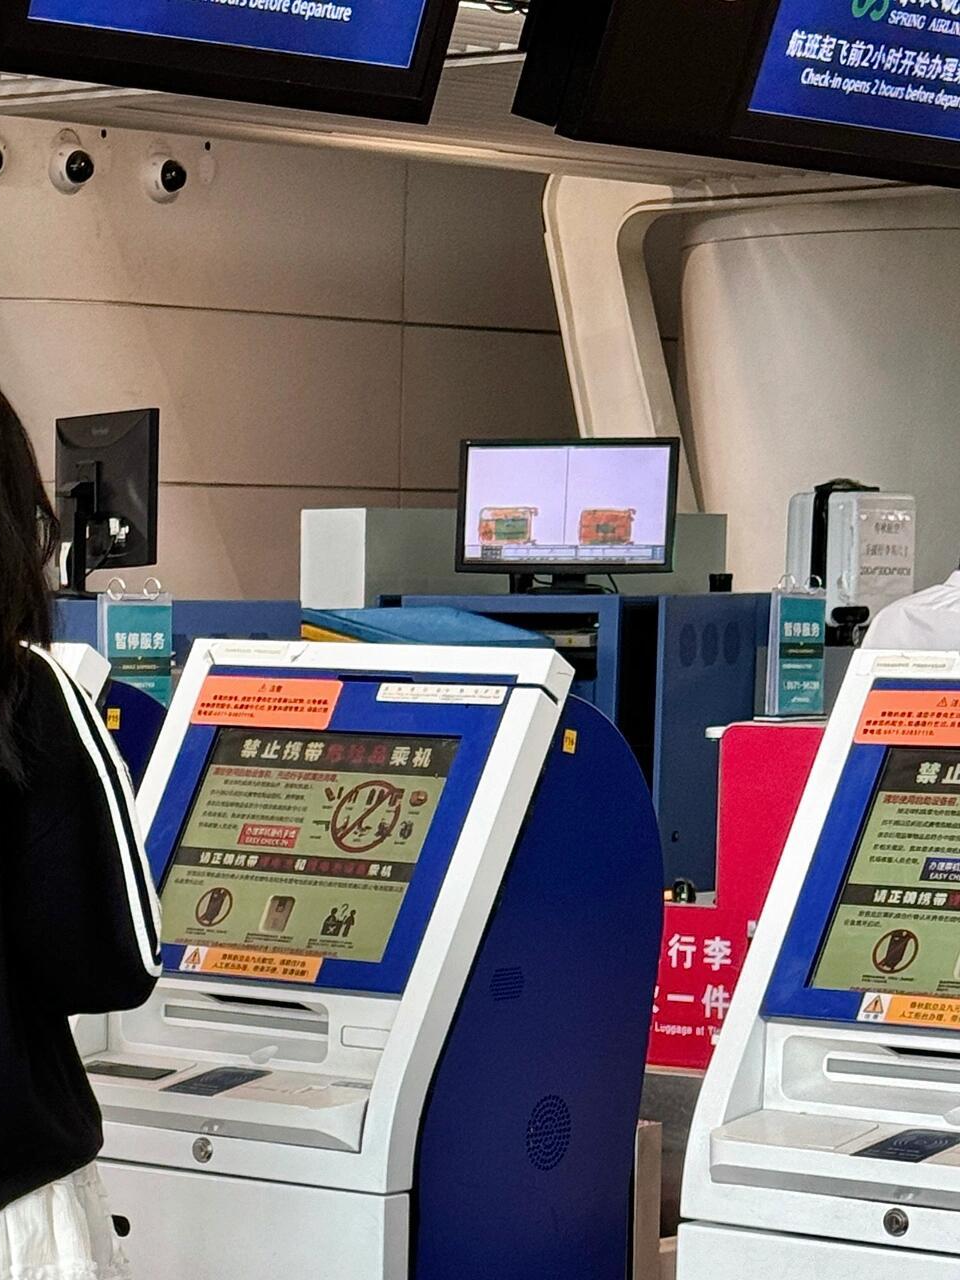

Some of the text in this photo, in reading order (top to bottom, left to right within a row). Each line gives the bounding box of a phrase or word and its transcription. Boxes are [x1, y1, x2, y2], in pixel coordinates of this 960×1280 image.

[249, 0, 290, 13] before
[292, 2, 352, 21] departure
[888, 10, 927, 30] SPRING
[785, 29, 960, 84] 航班起飞前2小时开始办理
[801, 67, 842, 90] Check-in
[842, 77, 872, 95] opens
[871, 79, 881, 95] 2
[878, 82, 906, 99] hours
[905, 85, 936, 105] before
[115, 632, 166, 650] 暂停服务
[667, 933, 732, 972] 行李
[652, 984, 730, 1020] 一件
